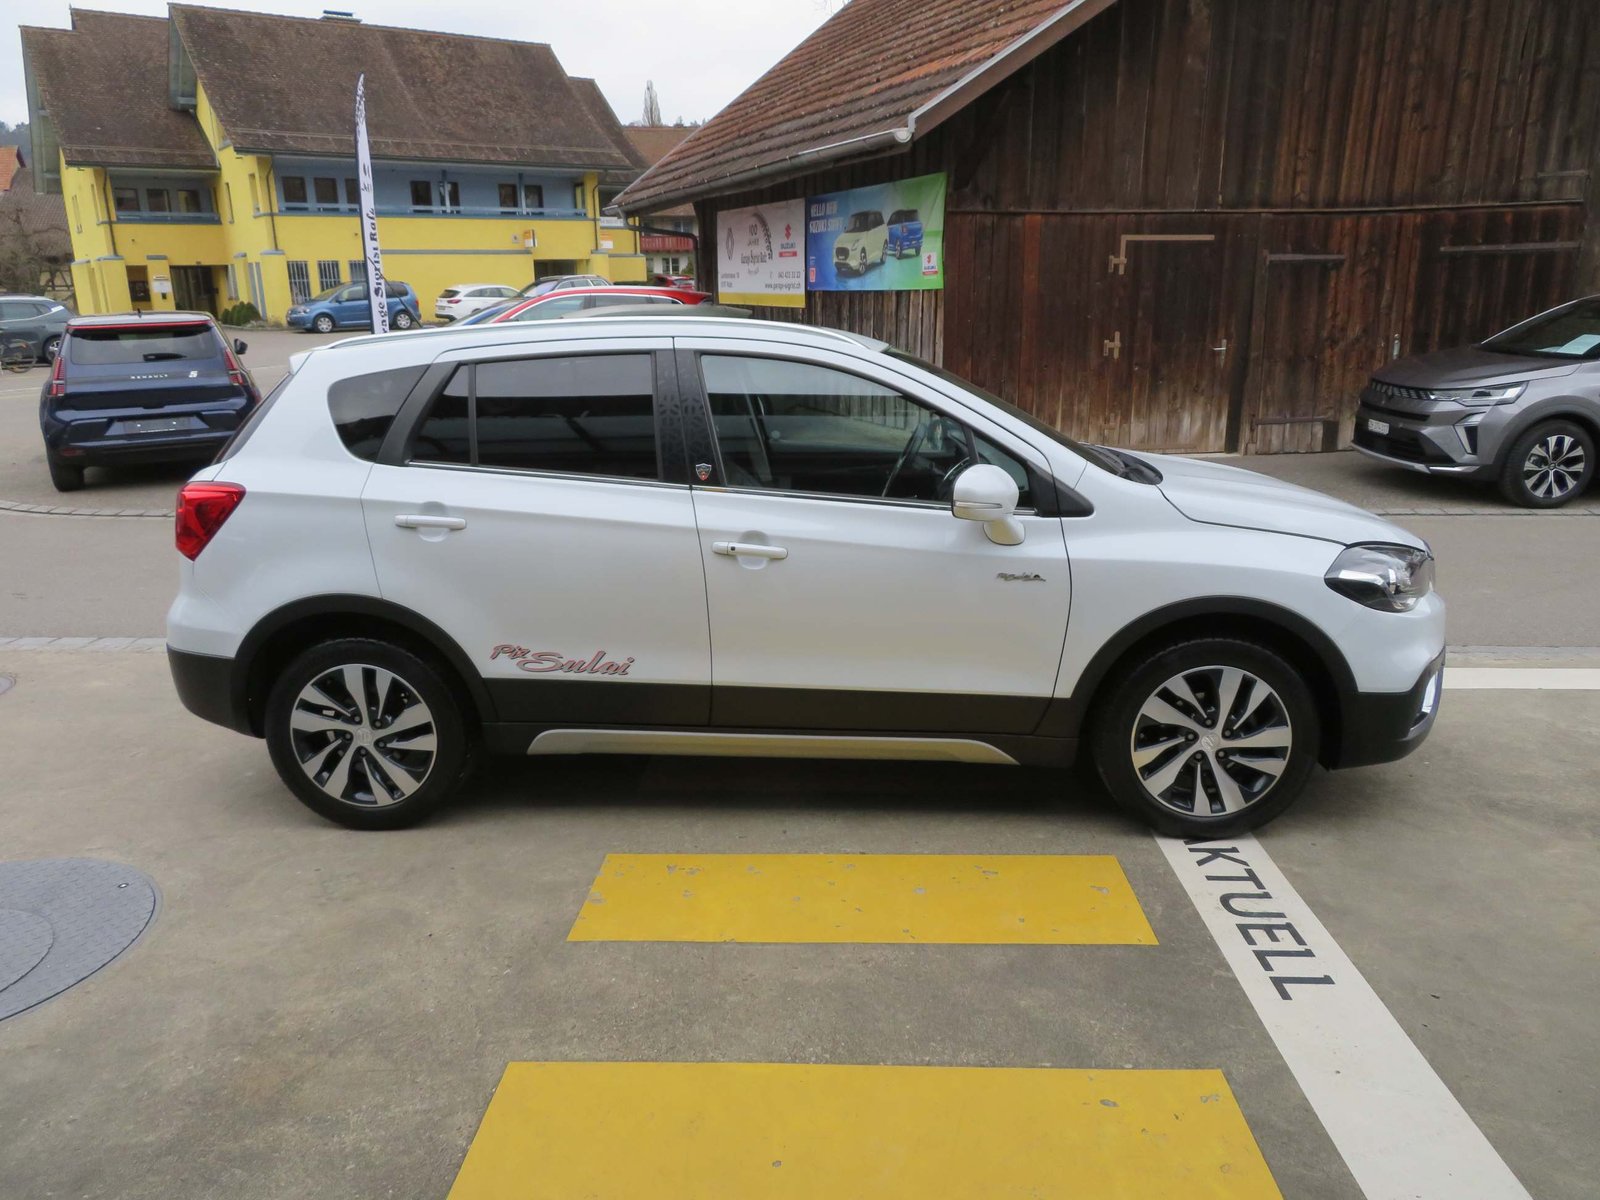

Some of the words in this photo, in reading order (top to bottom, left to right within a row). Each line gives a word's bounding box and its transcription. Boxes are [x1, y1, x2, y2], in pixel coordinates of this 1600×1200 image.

[378, 302, 388, 334] rage
[490, 644, 531, 660] Piz
[516, 651, 635, 675] Sulai
